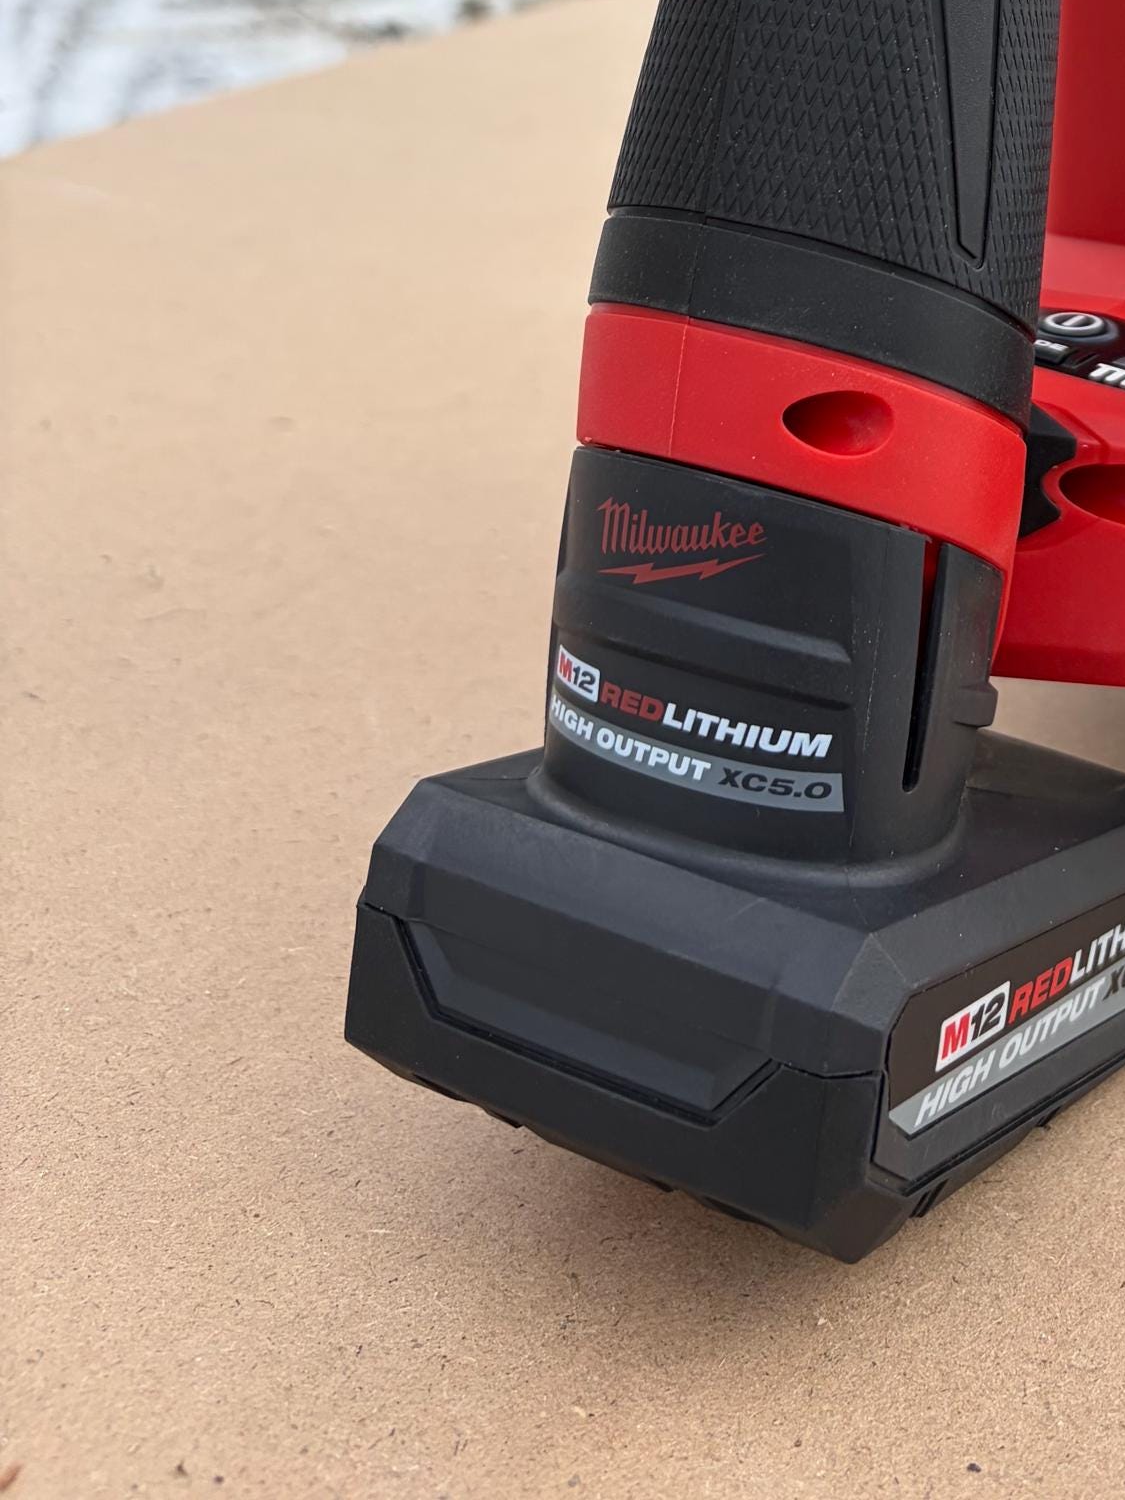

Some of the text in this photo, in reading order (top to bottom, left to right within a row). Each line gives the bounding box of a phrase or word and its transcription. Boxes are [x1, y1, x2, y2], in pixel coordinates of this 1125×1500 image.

[597, 495, 768, 555] Milwaukee
[551, 694, 833, 800] HIGH OUTPUT XC5.0
[558, 651, 833, 759] M12 REDLITHIUM
[914, 1048, 998, 1129] HIGH
[999, 975, 1107, 1070] OUTPUT
[940, 991, 1006, 1061] M12
